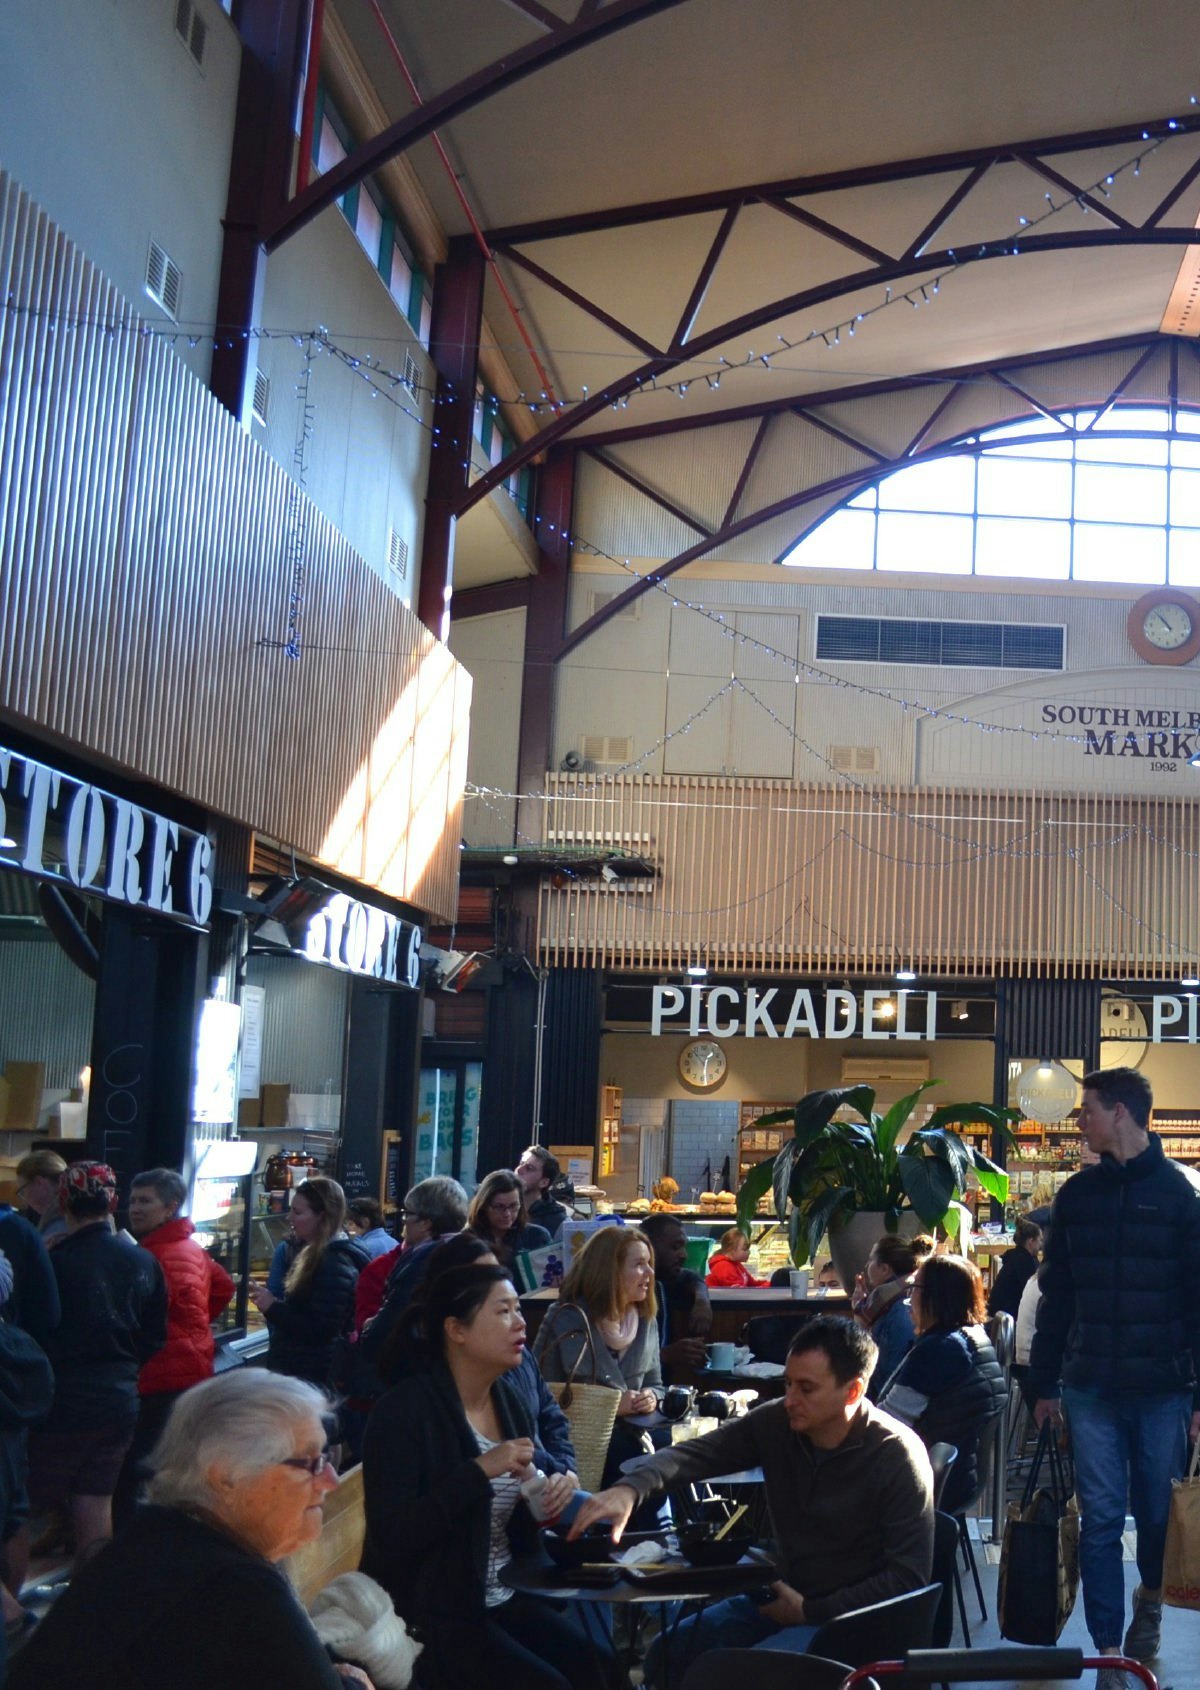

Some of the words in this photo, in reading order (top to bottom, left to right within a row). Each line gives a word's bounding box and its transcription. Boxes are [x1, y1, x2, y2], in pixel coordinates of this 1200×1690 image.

[1041, 704, 1130, 727] SOUTH
[1150, 763, 1177, 772] 1992
[191, 834, 212, 925] 6
[408, 925, 420, 988] 6
[651, 985, 937, 1041] PICKADELI
